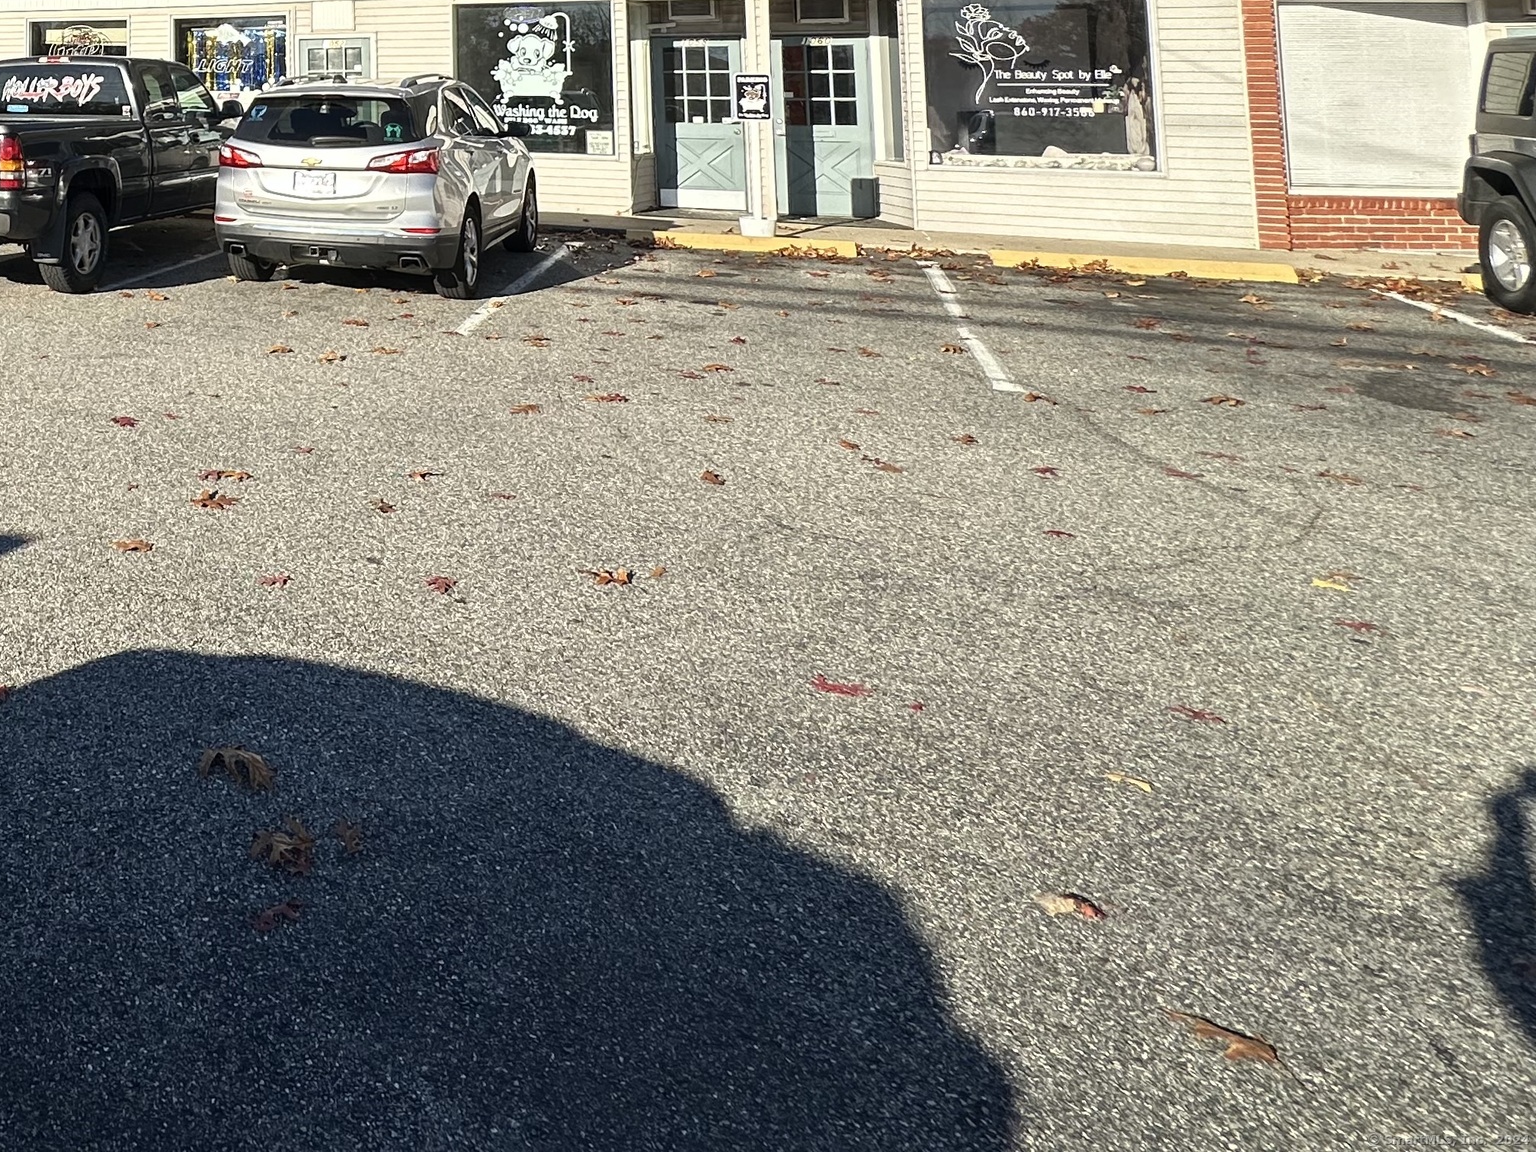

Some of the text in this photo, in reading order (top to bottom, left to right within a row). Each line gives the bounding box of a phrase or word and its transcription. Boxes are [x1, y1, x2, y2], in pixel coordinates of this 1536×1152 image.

[197, 59, 253, 74] LIGHT
[994, 69, 1112, 81] The Beauty Spot by Elle
[493, 104, 598, 123] Washing the Dog
